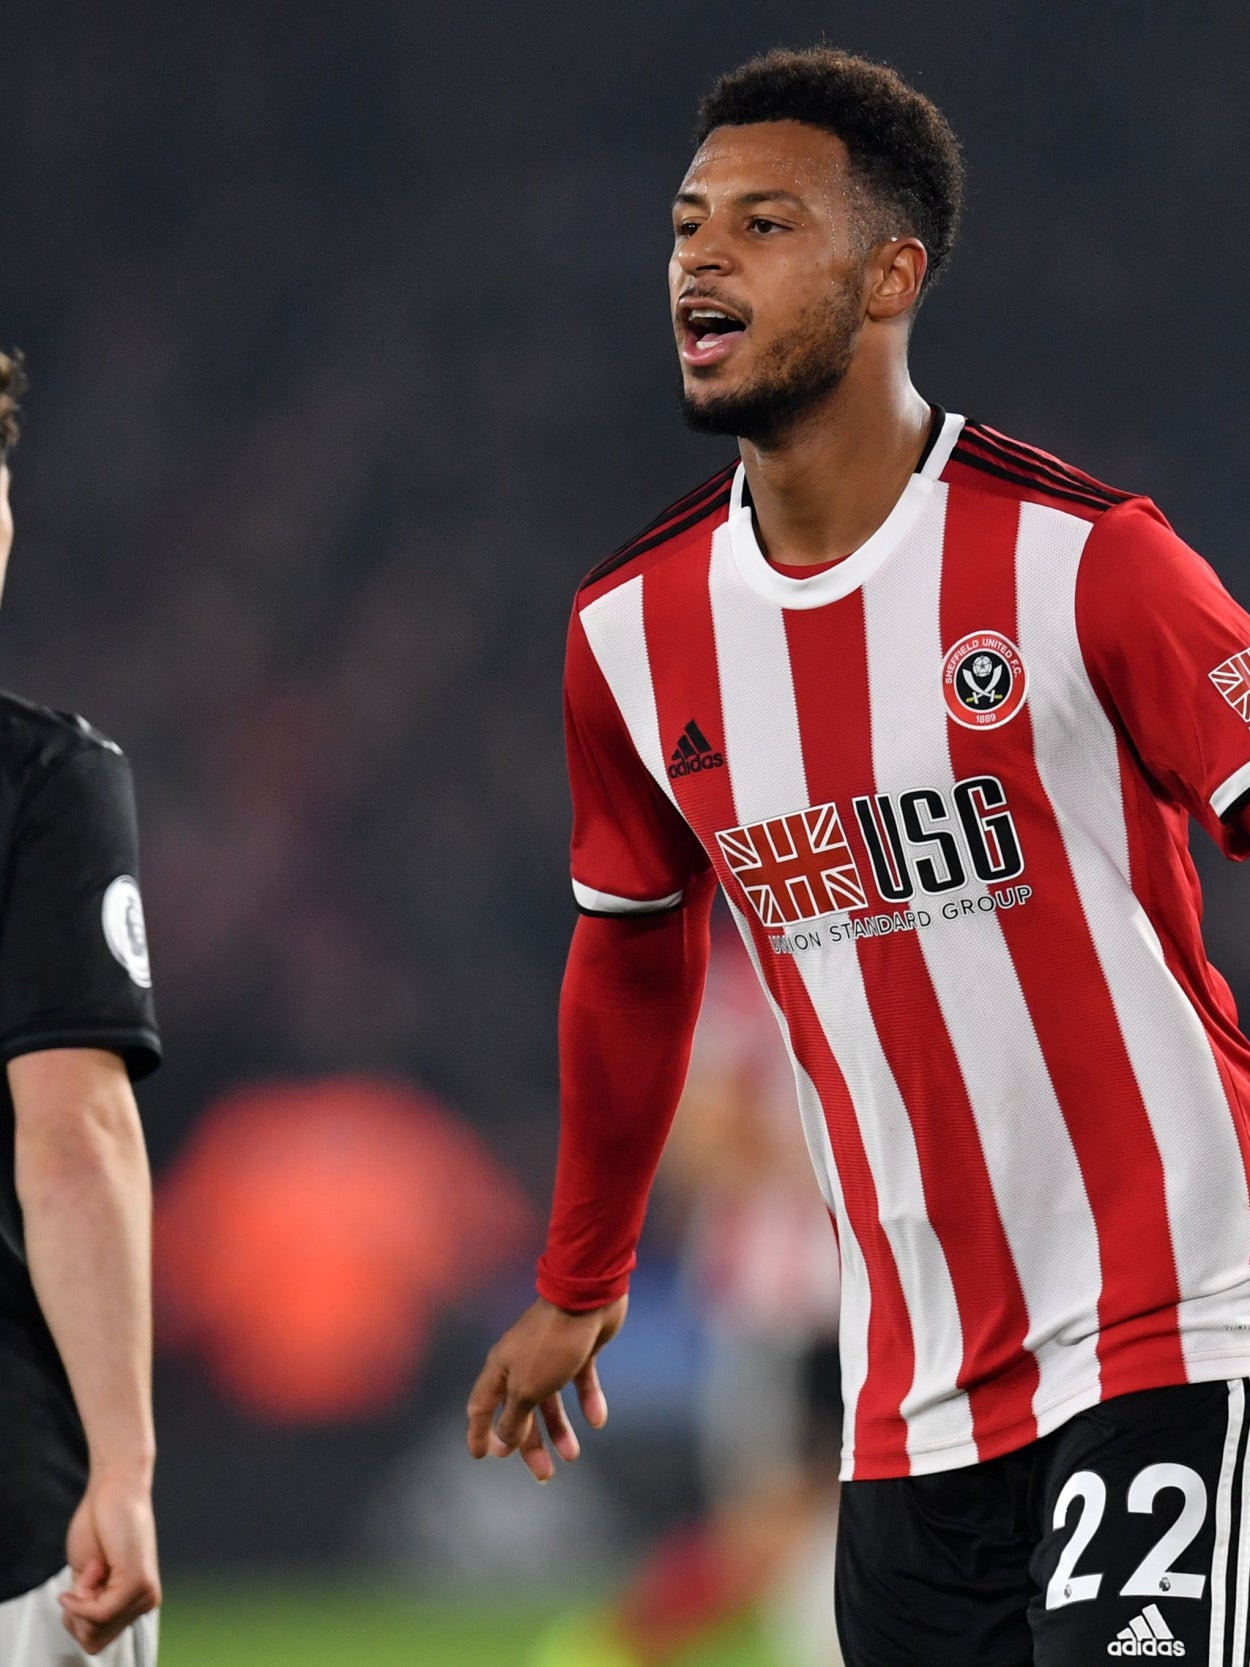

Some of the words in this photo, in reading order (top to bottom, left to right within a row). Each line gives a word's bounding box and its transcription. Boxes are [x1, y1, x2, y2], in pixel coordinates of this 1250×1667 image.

[945, 640, 979, 684] SHEFFIELD
[982, 638, 1013, 659] UNITED
[1010, 659, 1022, 677] F.C.
[975, 713, 996, 723] 1889
[668, 752, 724, 778] adidas
[852, 775, 1025, 903] USG
[771, 932, 822, 955] UNION
[829, 909, 931, 943] STANDARD
[941, 885, 1034, 921] GROUP
[1046, 1462, 1208, 1610] 22
[1107, 1637, 1186, 1657] adidas
